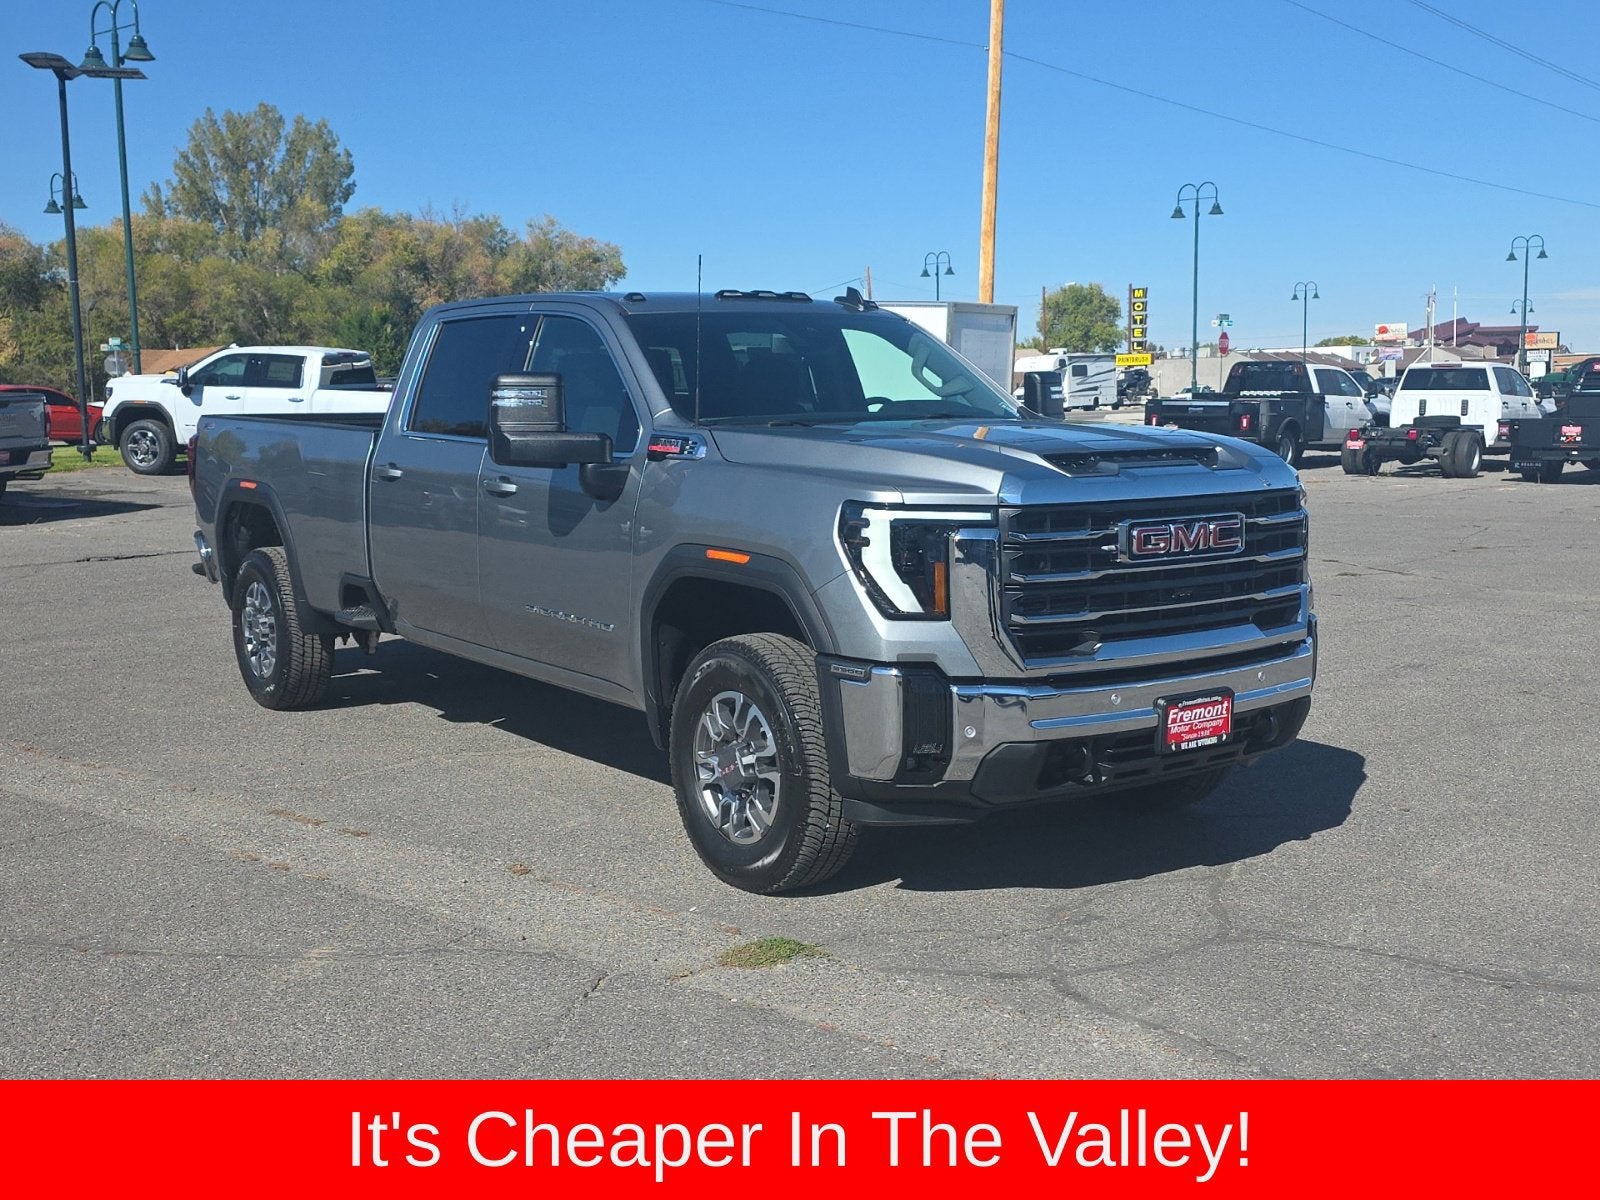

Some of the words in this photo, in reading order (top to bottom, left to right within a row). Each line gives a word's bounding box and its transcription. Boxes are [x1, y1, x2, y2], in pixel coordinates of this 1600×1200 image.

[1134, 289, 1144, 350] MOTEL
[1117, 356, 1149, 364] PAINTBRUSH
[1132, 521, 1241, 555] GMC
[1168, 701, 1229, 725] Fremont
[1170, 724, 1191, 735] Motor
[1192, 718, 1224, 730] Company
